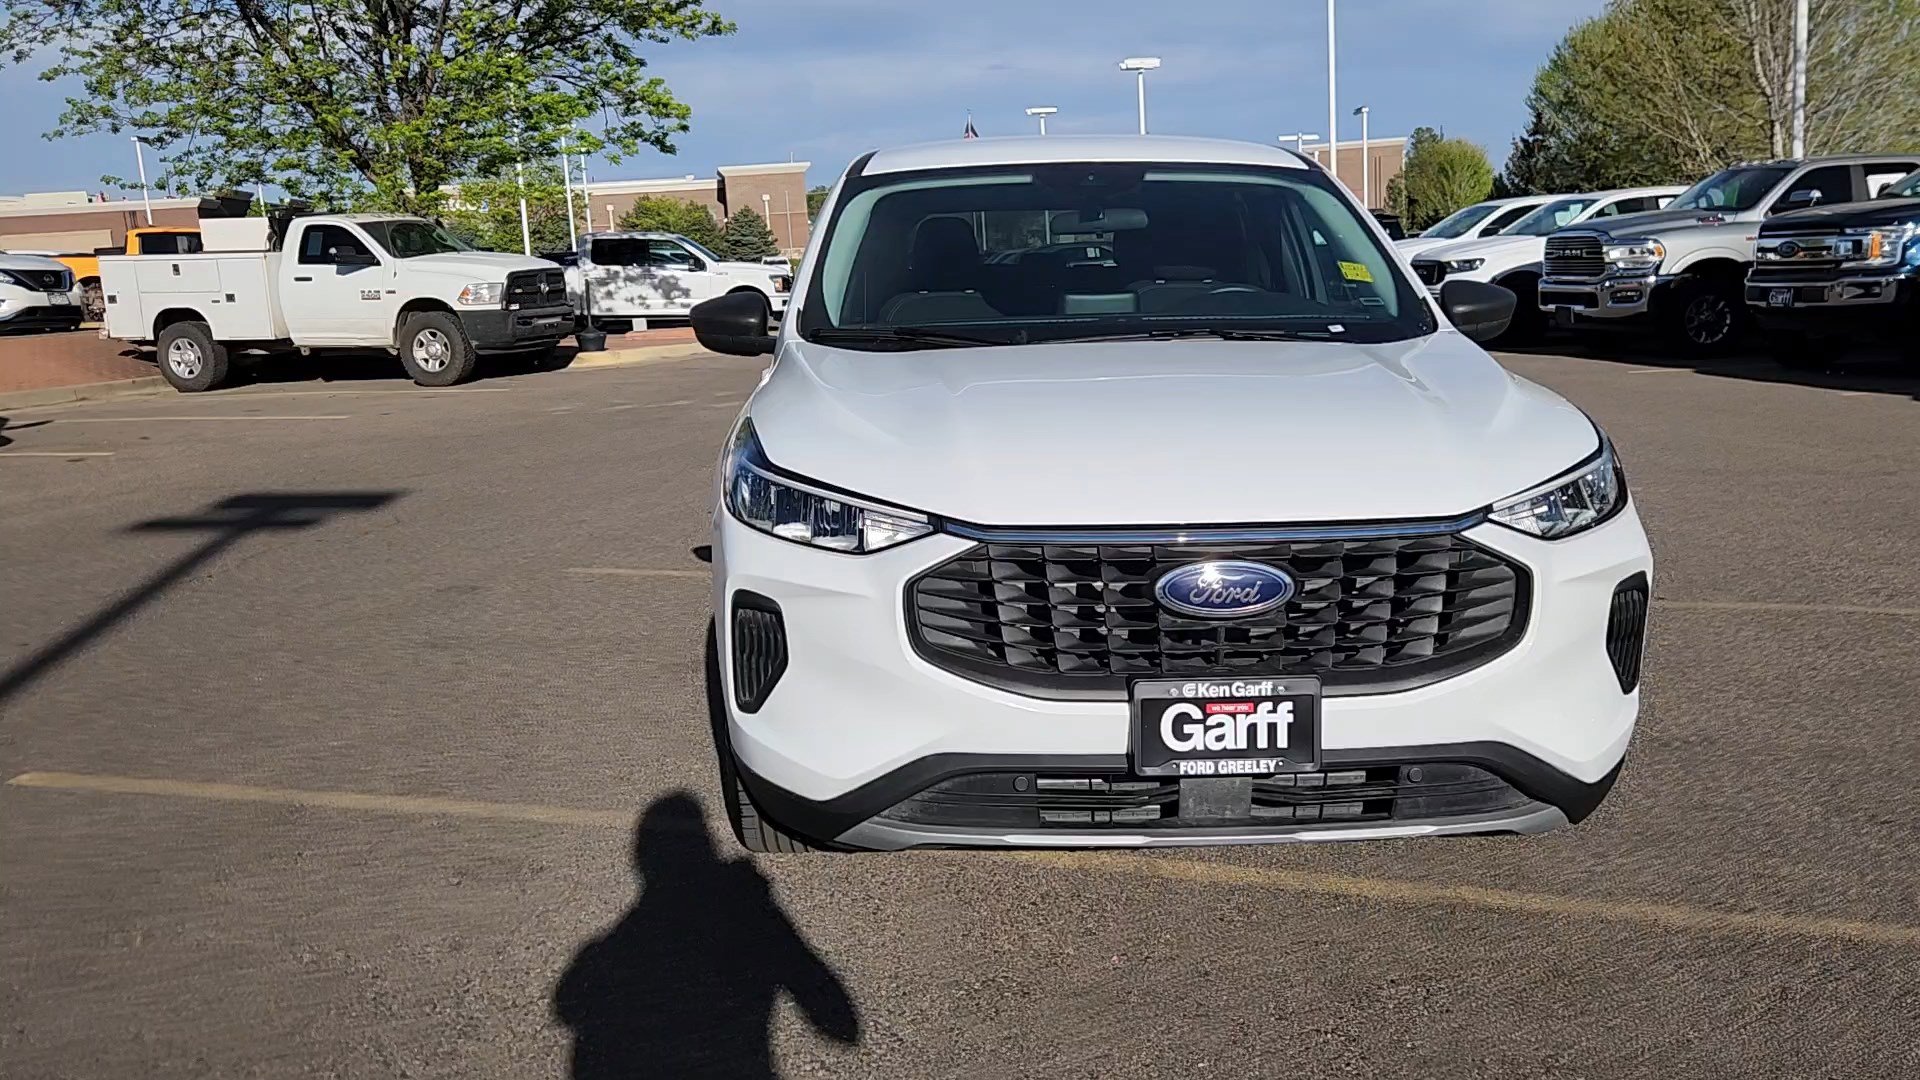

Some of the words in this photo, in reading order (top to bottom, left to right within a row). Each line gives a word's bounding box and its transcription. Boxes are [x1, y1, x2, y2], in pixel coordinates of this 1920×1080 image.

[1189, 567, 1263, 605] Ford
[1197, 682, 1230, 697] Ken
[1231, 682, 1274, 697] Garff
[1160, 701, 1294, 752] Garff
[1180, 761, 1215, 775] FORD
[1217, 760, 1278, 774] GREELEY
